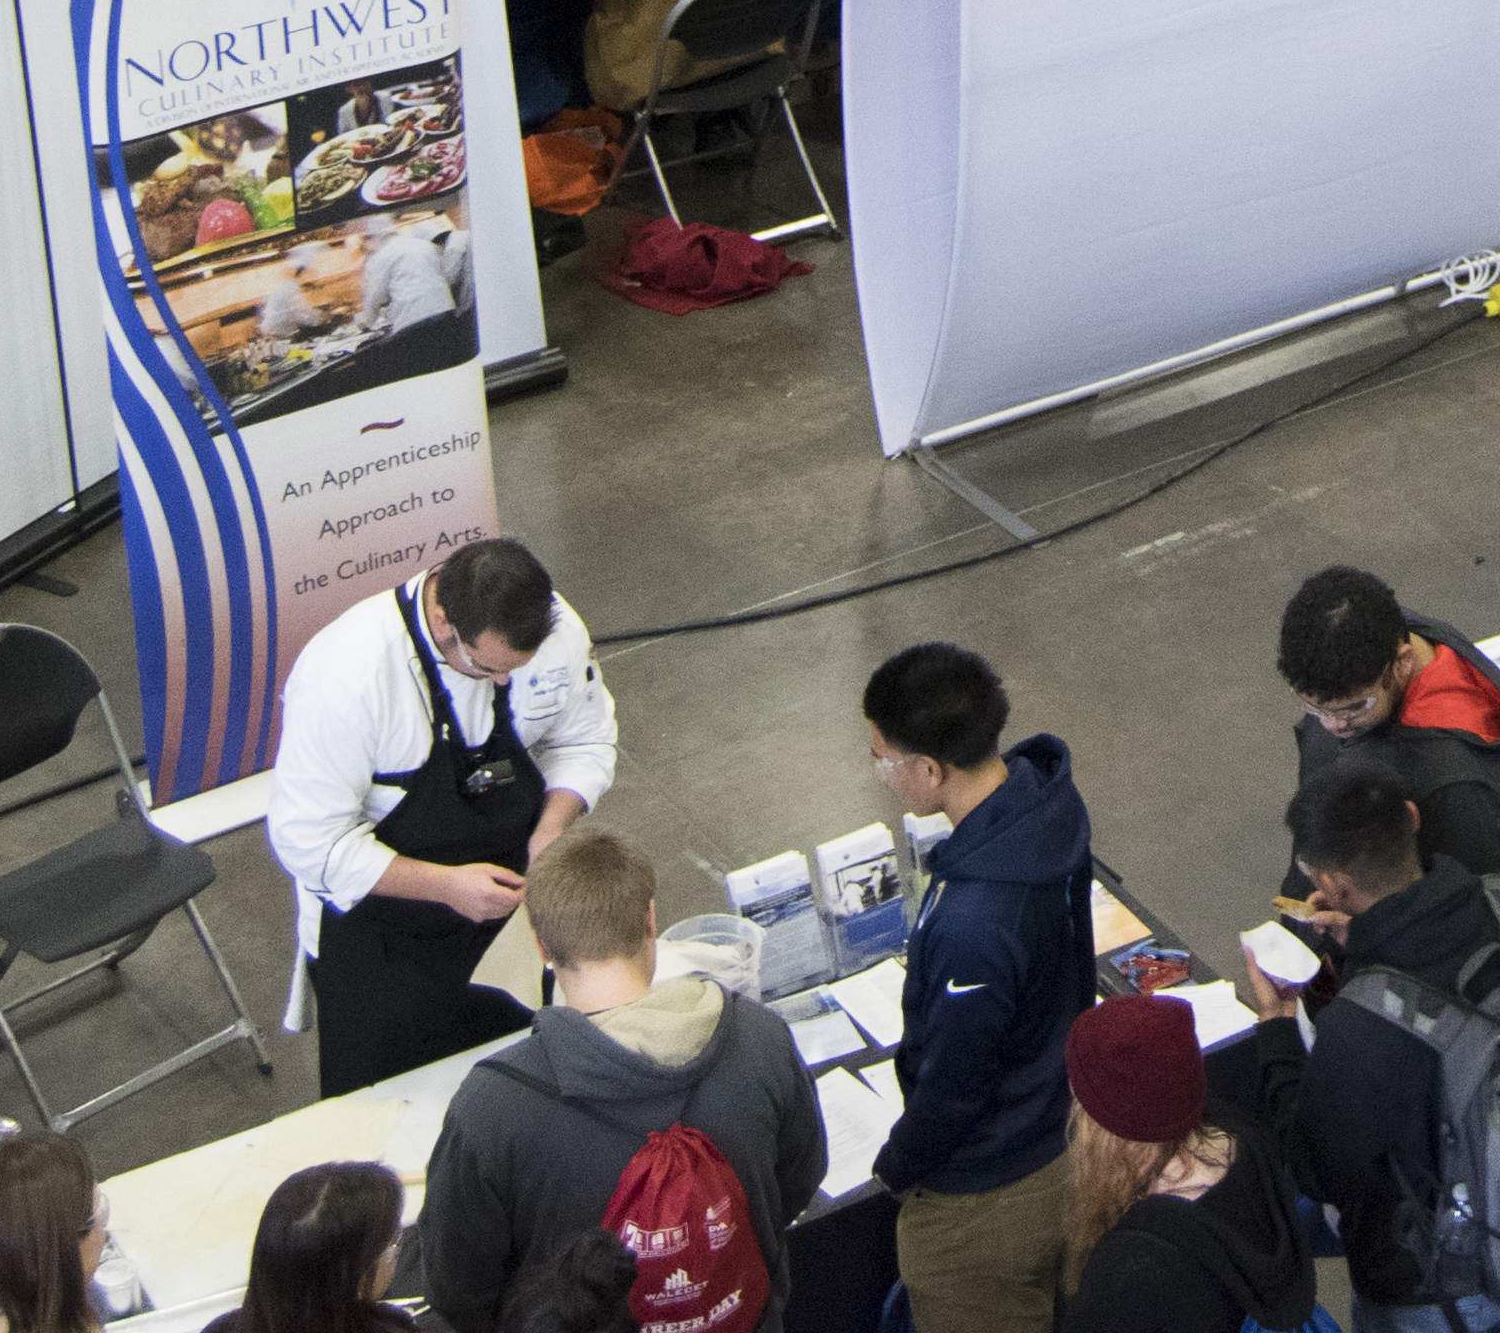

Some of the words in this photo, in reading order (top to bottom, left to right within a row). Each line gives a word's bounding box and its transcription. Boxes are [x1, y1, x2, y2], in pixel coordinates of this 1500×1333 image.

[138, 64, 281, 118] CULINARY
[298, 21, 449, 74] INSTITUTE
[281, 481, 312, 504] An
[321, 430, 482, 490] Apprenticeship
[318, 492, 424, 540] Approach
[431, 487, 455, 505] to
[293, 573, 330, 596] the
[336, 540, 428, 581] Culinary
[434, 525, 488, 552] Arts.
[709, 1289, 743, 1323] DAY
